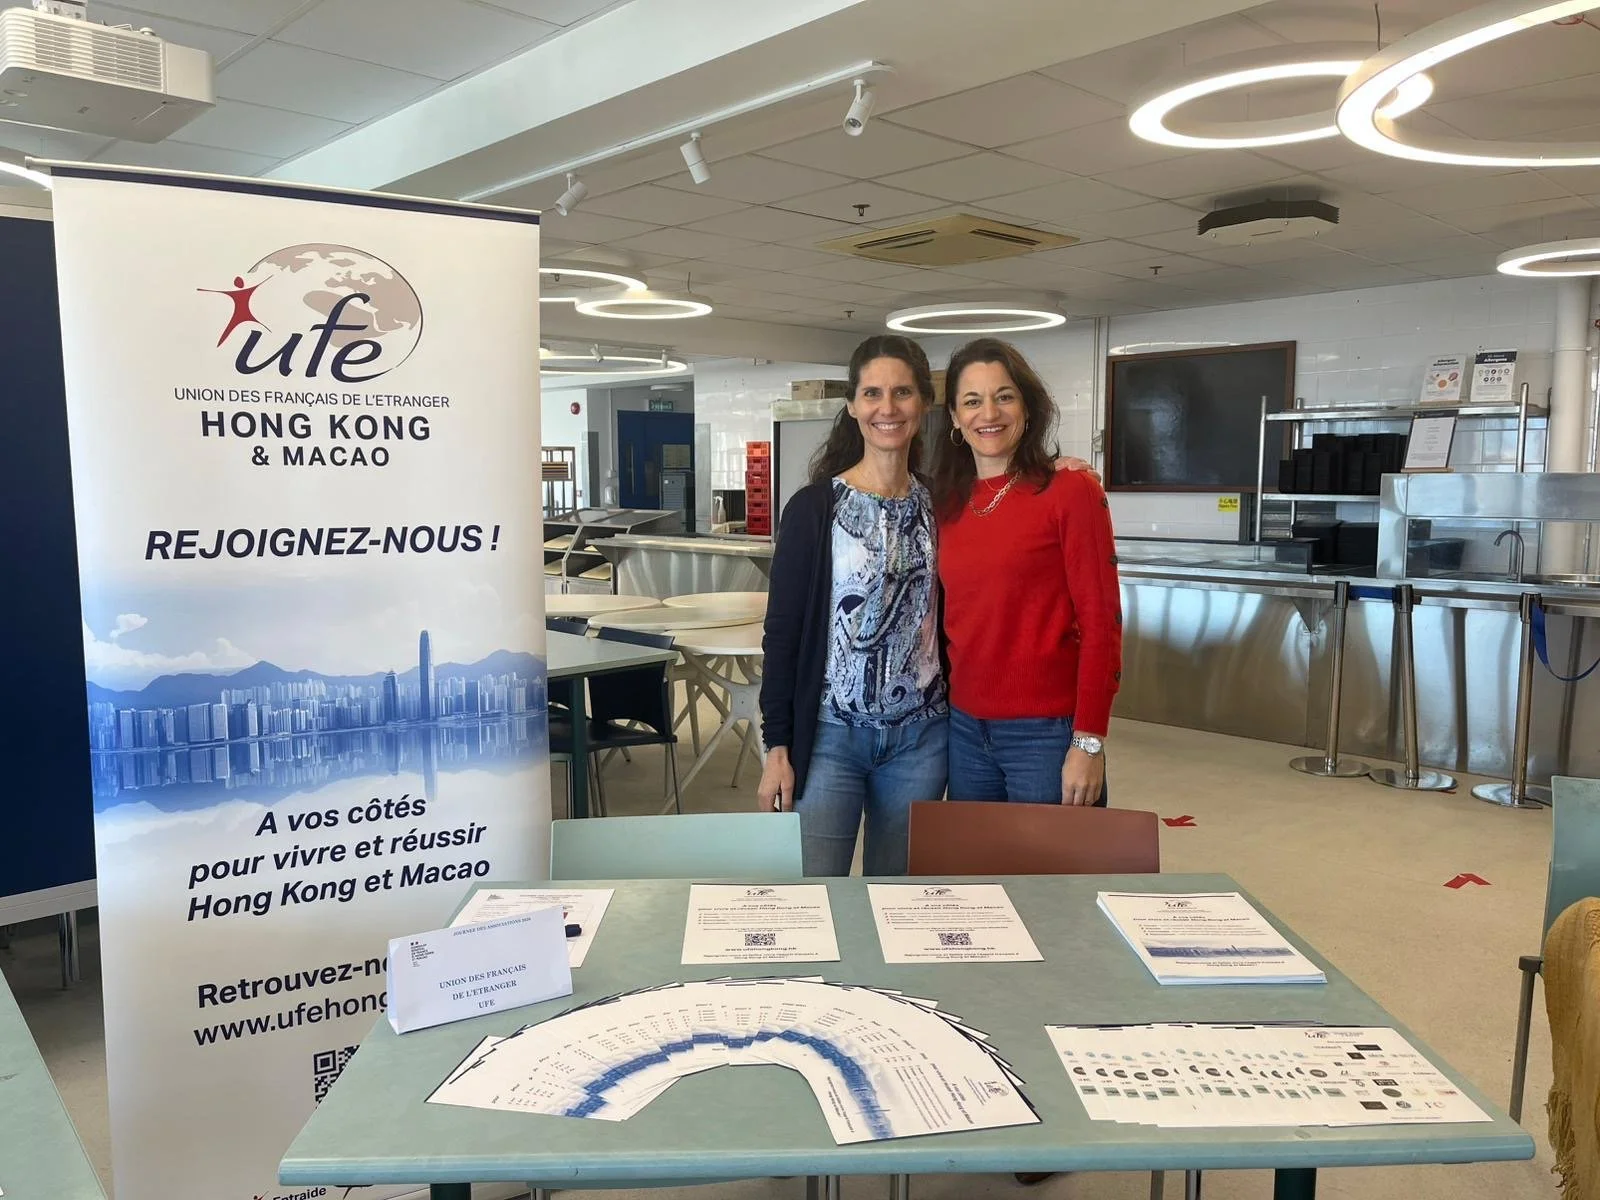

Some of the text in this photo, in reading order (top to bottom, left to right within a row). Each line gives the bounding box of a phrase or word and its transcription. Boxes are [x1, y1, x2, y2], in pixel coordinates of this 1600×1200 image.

[235, 293, 393, 383] ufe
[174, 388, 450, 408] UNION DES FRANÇAIS DE L'ETRANGER
[201, 411, 430, 441] HONG KONG
[251, 446, 390, 466] & MACAO
[145, 525, 500, 560] REJOIGNEZ-NOUS !
[255, 794, 426, 836] A vos côtés
[188, 822, 487, 889] pour vivre et réussir
[187, 859, 490, 921] Hong Kong et Macao
[439, 963, 527, 989] UNION DES FRANÇAIS
[452, 979, 517, 1001] DE L'ETRANGER
[478, 999, 496, 1009] UFE
